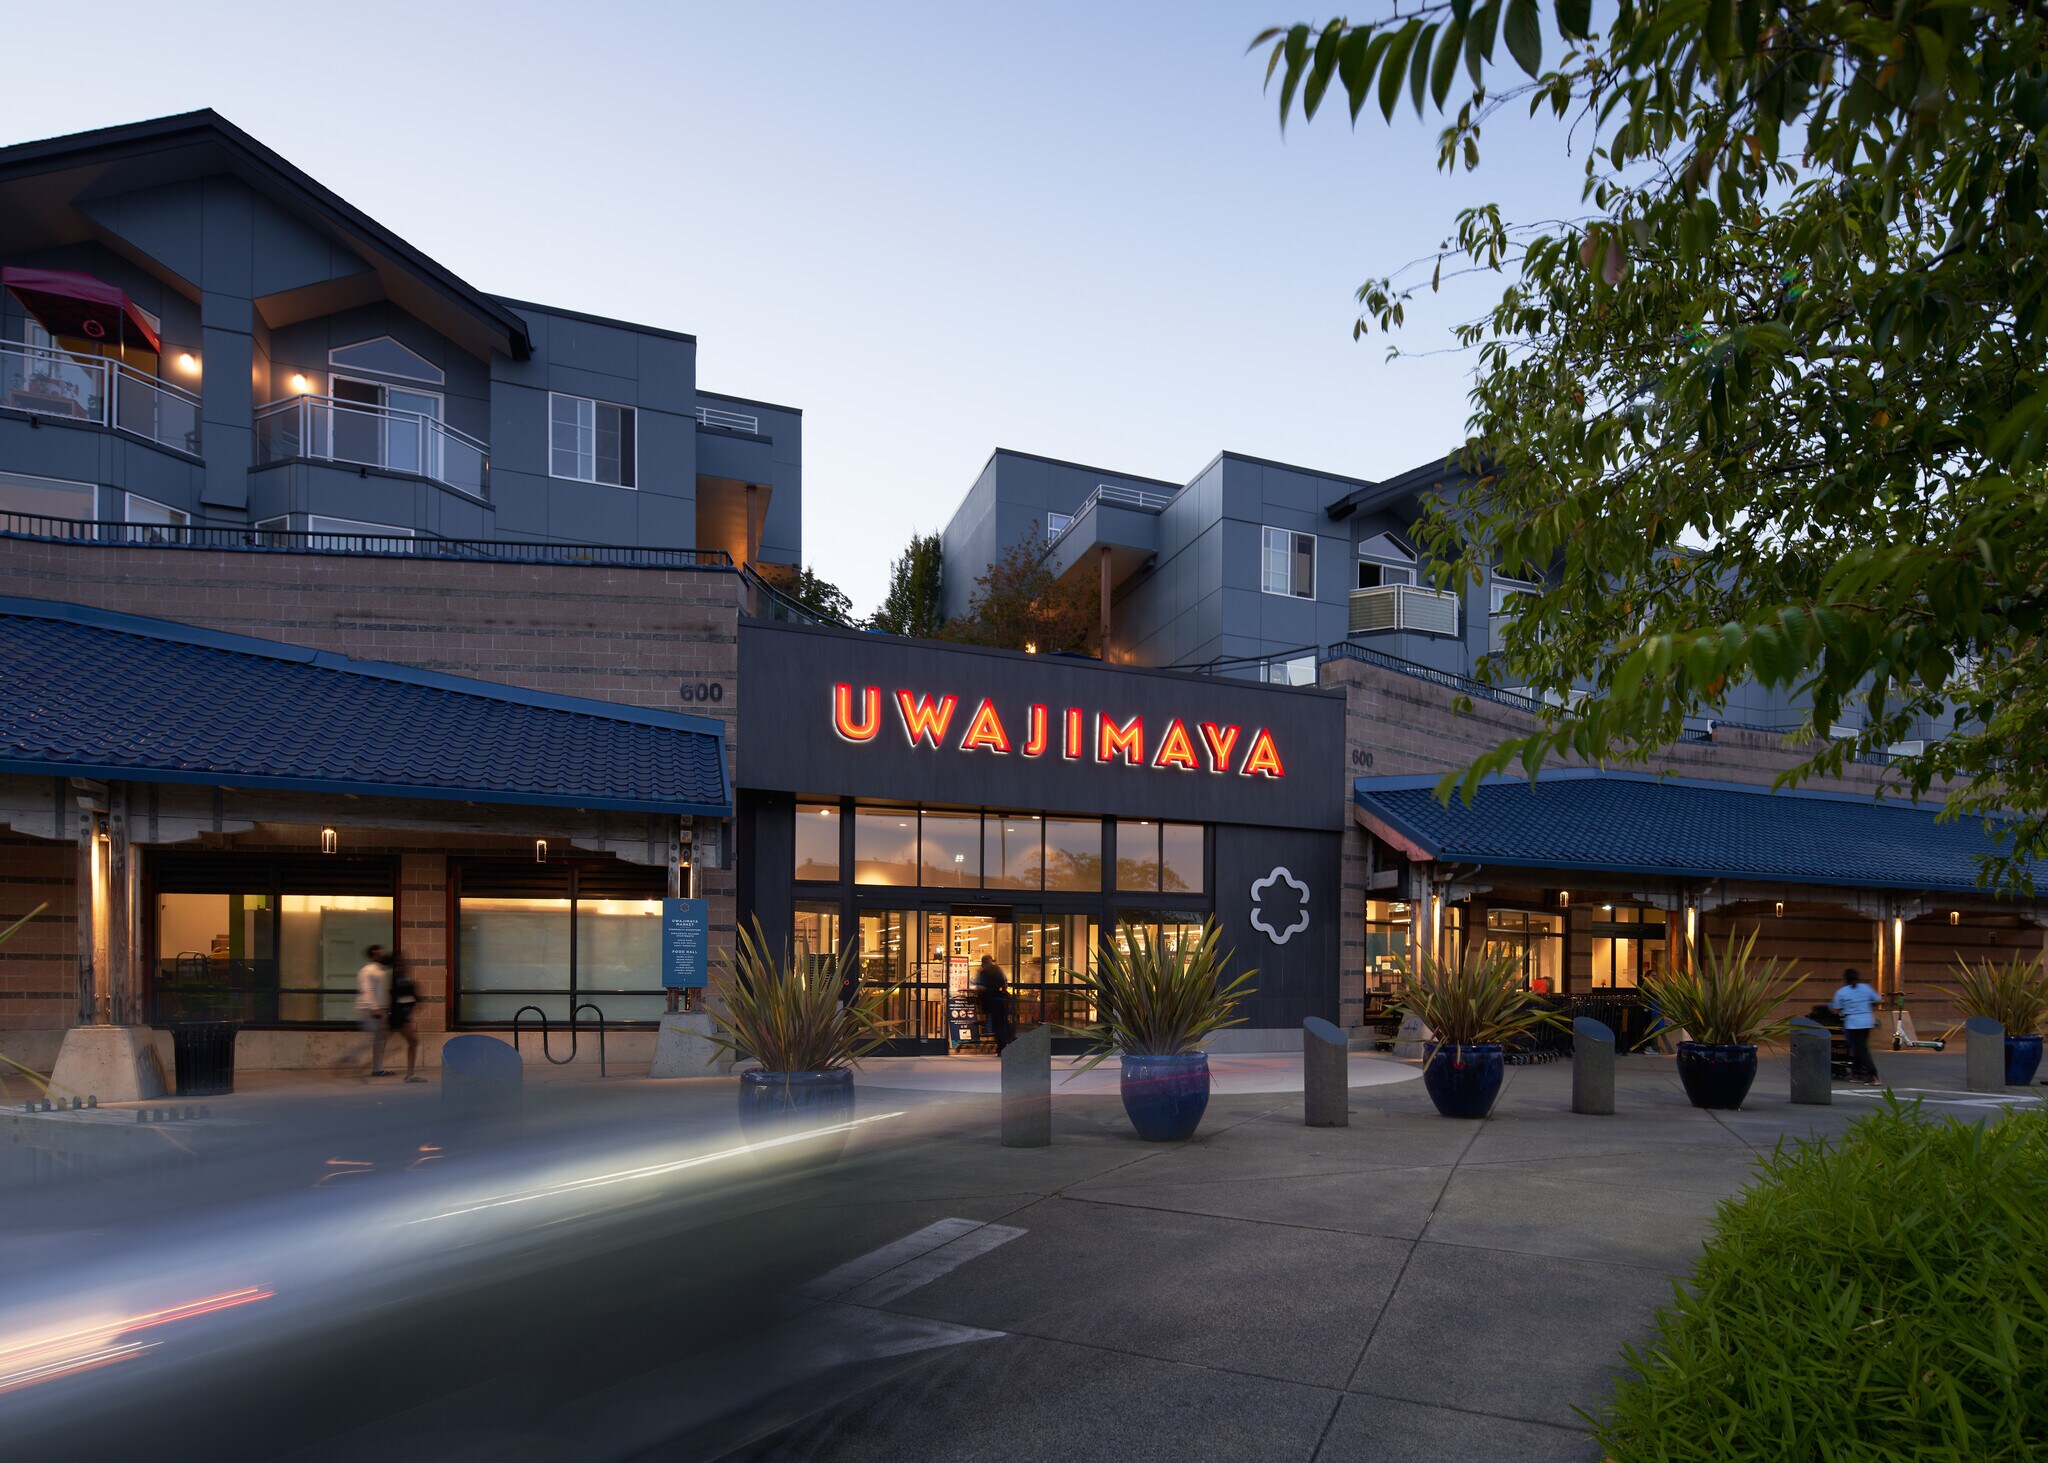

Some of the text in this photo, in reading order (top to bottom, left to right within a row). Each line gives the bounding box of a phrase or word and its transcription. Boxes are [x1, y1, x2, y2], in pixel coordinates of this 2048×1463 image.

[681, 682, 723, 702] 600
[833, 682, 1286, 778] UWAJIMAYA
[1352, 749, 1373, 768] 600
